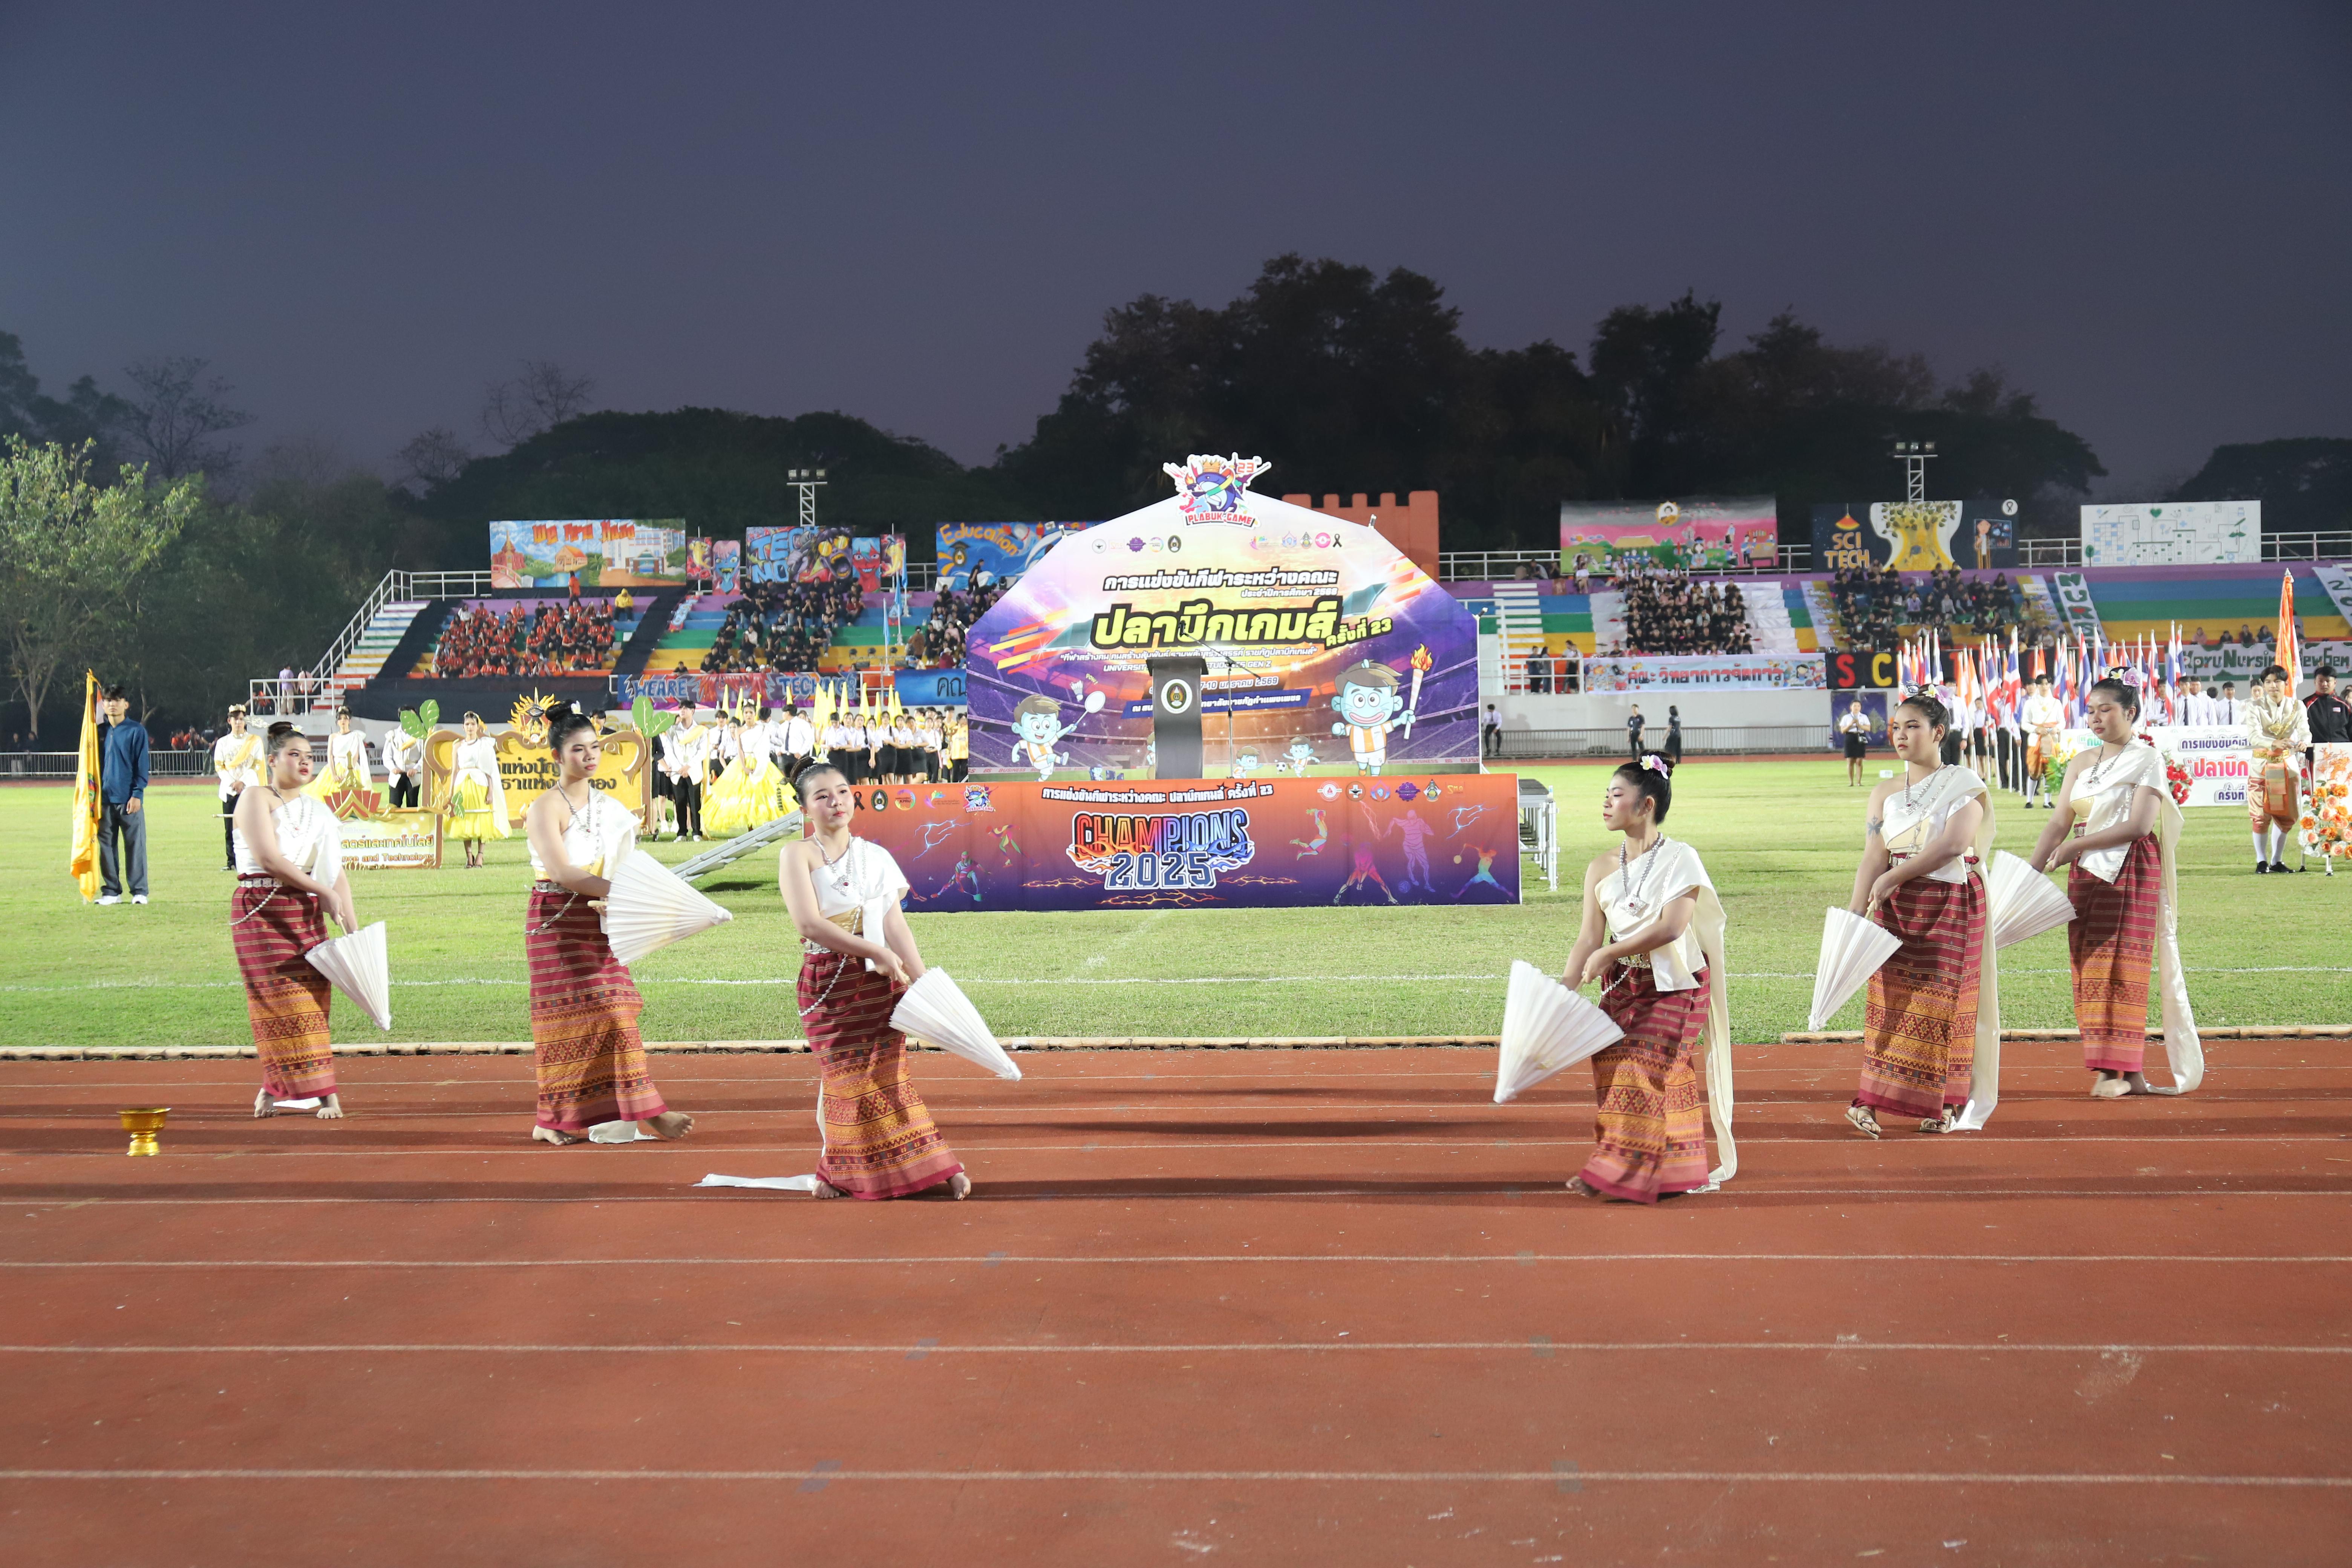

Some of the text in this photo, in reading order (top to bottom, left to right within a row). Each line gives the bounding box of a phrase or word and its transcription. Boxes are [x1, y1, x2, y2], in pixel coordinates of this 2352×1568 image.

[1237, 462, 1254, 473] 23
[1188, 513, 1253, 525] PLABUK GAME
[940, 522, 1019, 556] Education
[1832, 531, 1861, 550] SCI
[1824, 549, 1870, 569] TECH
[1105, 569, 1337, 589] การแข่งขันกีฬาระหว่างคณะ
[1241, 588, 1313, 597] ประจำปีการศึกษา
[1094, 601, 1338, 645] ปลาบึกเกมส์
[1326, 618, 1392, 647] ครั้งที่ 23
[2224, 649, 2276, 668] Nursin
[1628, 663, 1785, 685] คณะ วิทยาการจัดการ
[1836, 653, 1893, 688] S C
[1219, 679, 1253, 689] มกราคม
[1255, 677, 1279, 686] 2569
[1201, 695, 1302, 707] ทยาลัยราชภัฏกำแพงเพชร
[1043, 787, 1165, 803] การแข่งขันกีฬาระหว่างคณะ
[1228, 782, 1257, 799] ครั้งที่
[1260, 785, 1274, 796] 23
[2218, 784, 2245, 800] ครั้งที่
[341, 834, 434, 848] สตร์และเทคโนโลยี
[1076, 810, 1248, 855] CHAMPIONS
[362, 853, 379, 862] and
[382, 853, 434, 862] Technology
[1108, 852, 1213, 888] 2025
